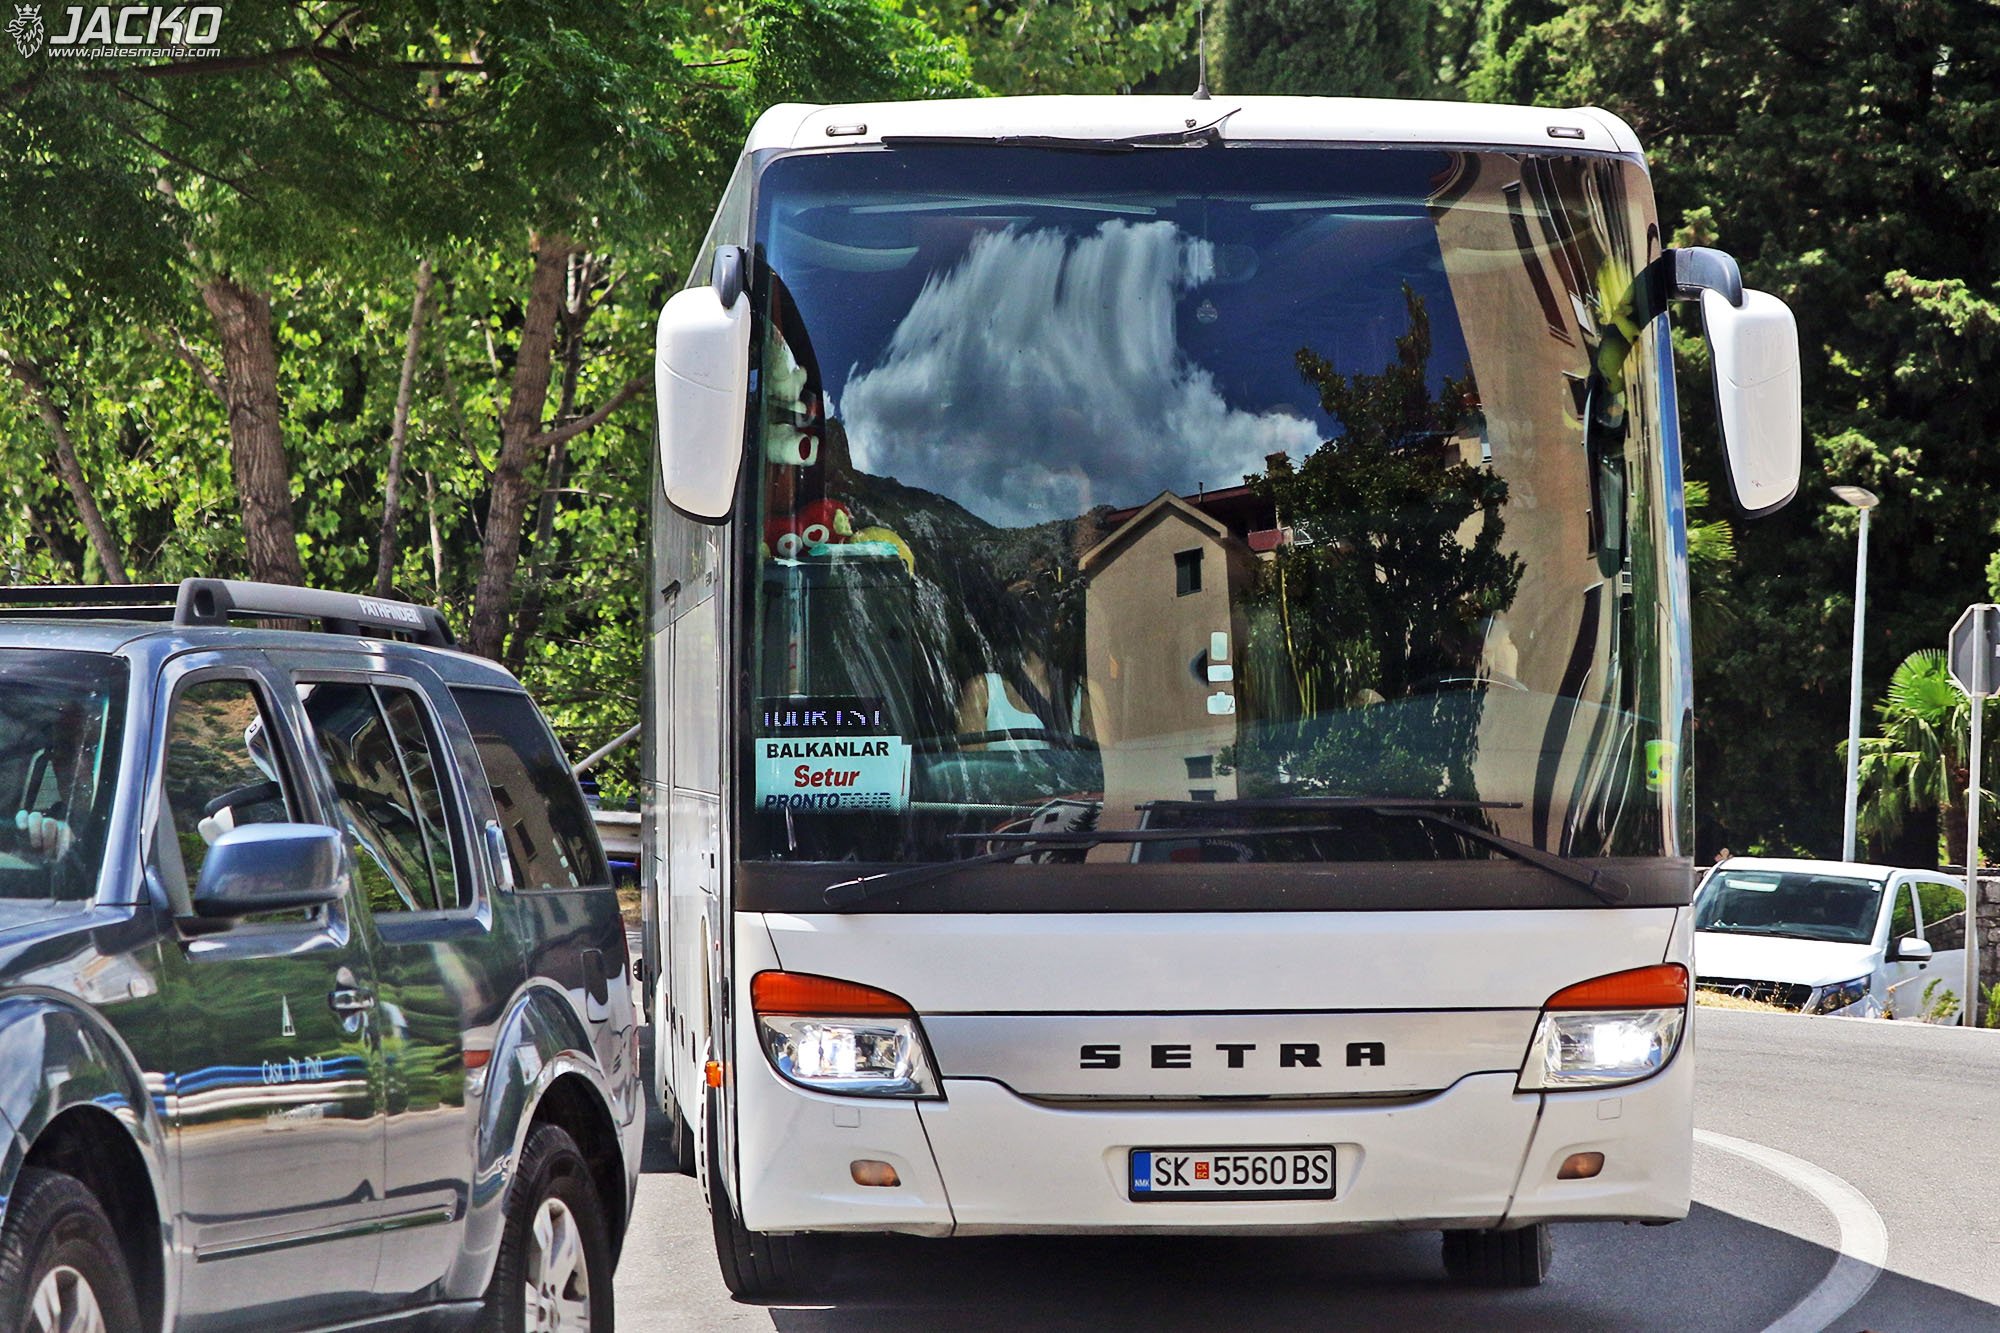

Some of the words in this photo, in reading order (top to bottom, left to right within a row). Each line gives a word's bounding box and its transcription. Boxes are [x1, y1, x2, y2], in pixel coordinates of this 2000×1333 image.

[359, 599, 421, 623] PATHFINDER
[766, 741, 889, 759] BALKANLAR
[794, 765, 861, 787] Setur
[1080, 1042, 1386, 1069] SETRA
[1154, 1156, 1190, 1187] SK
